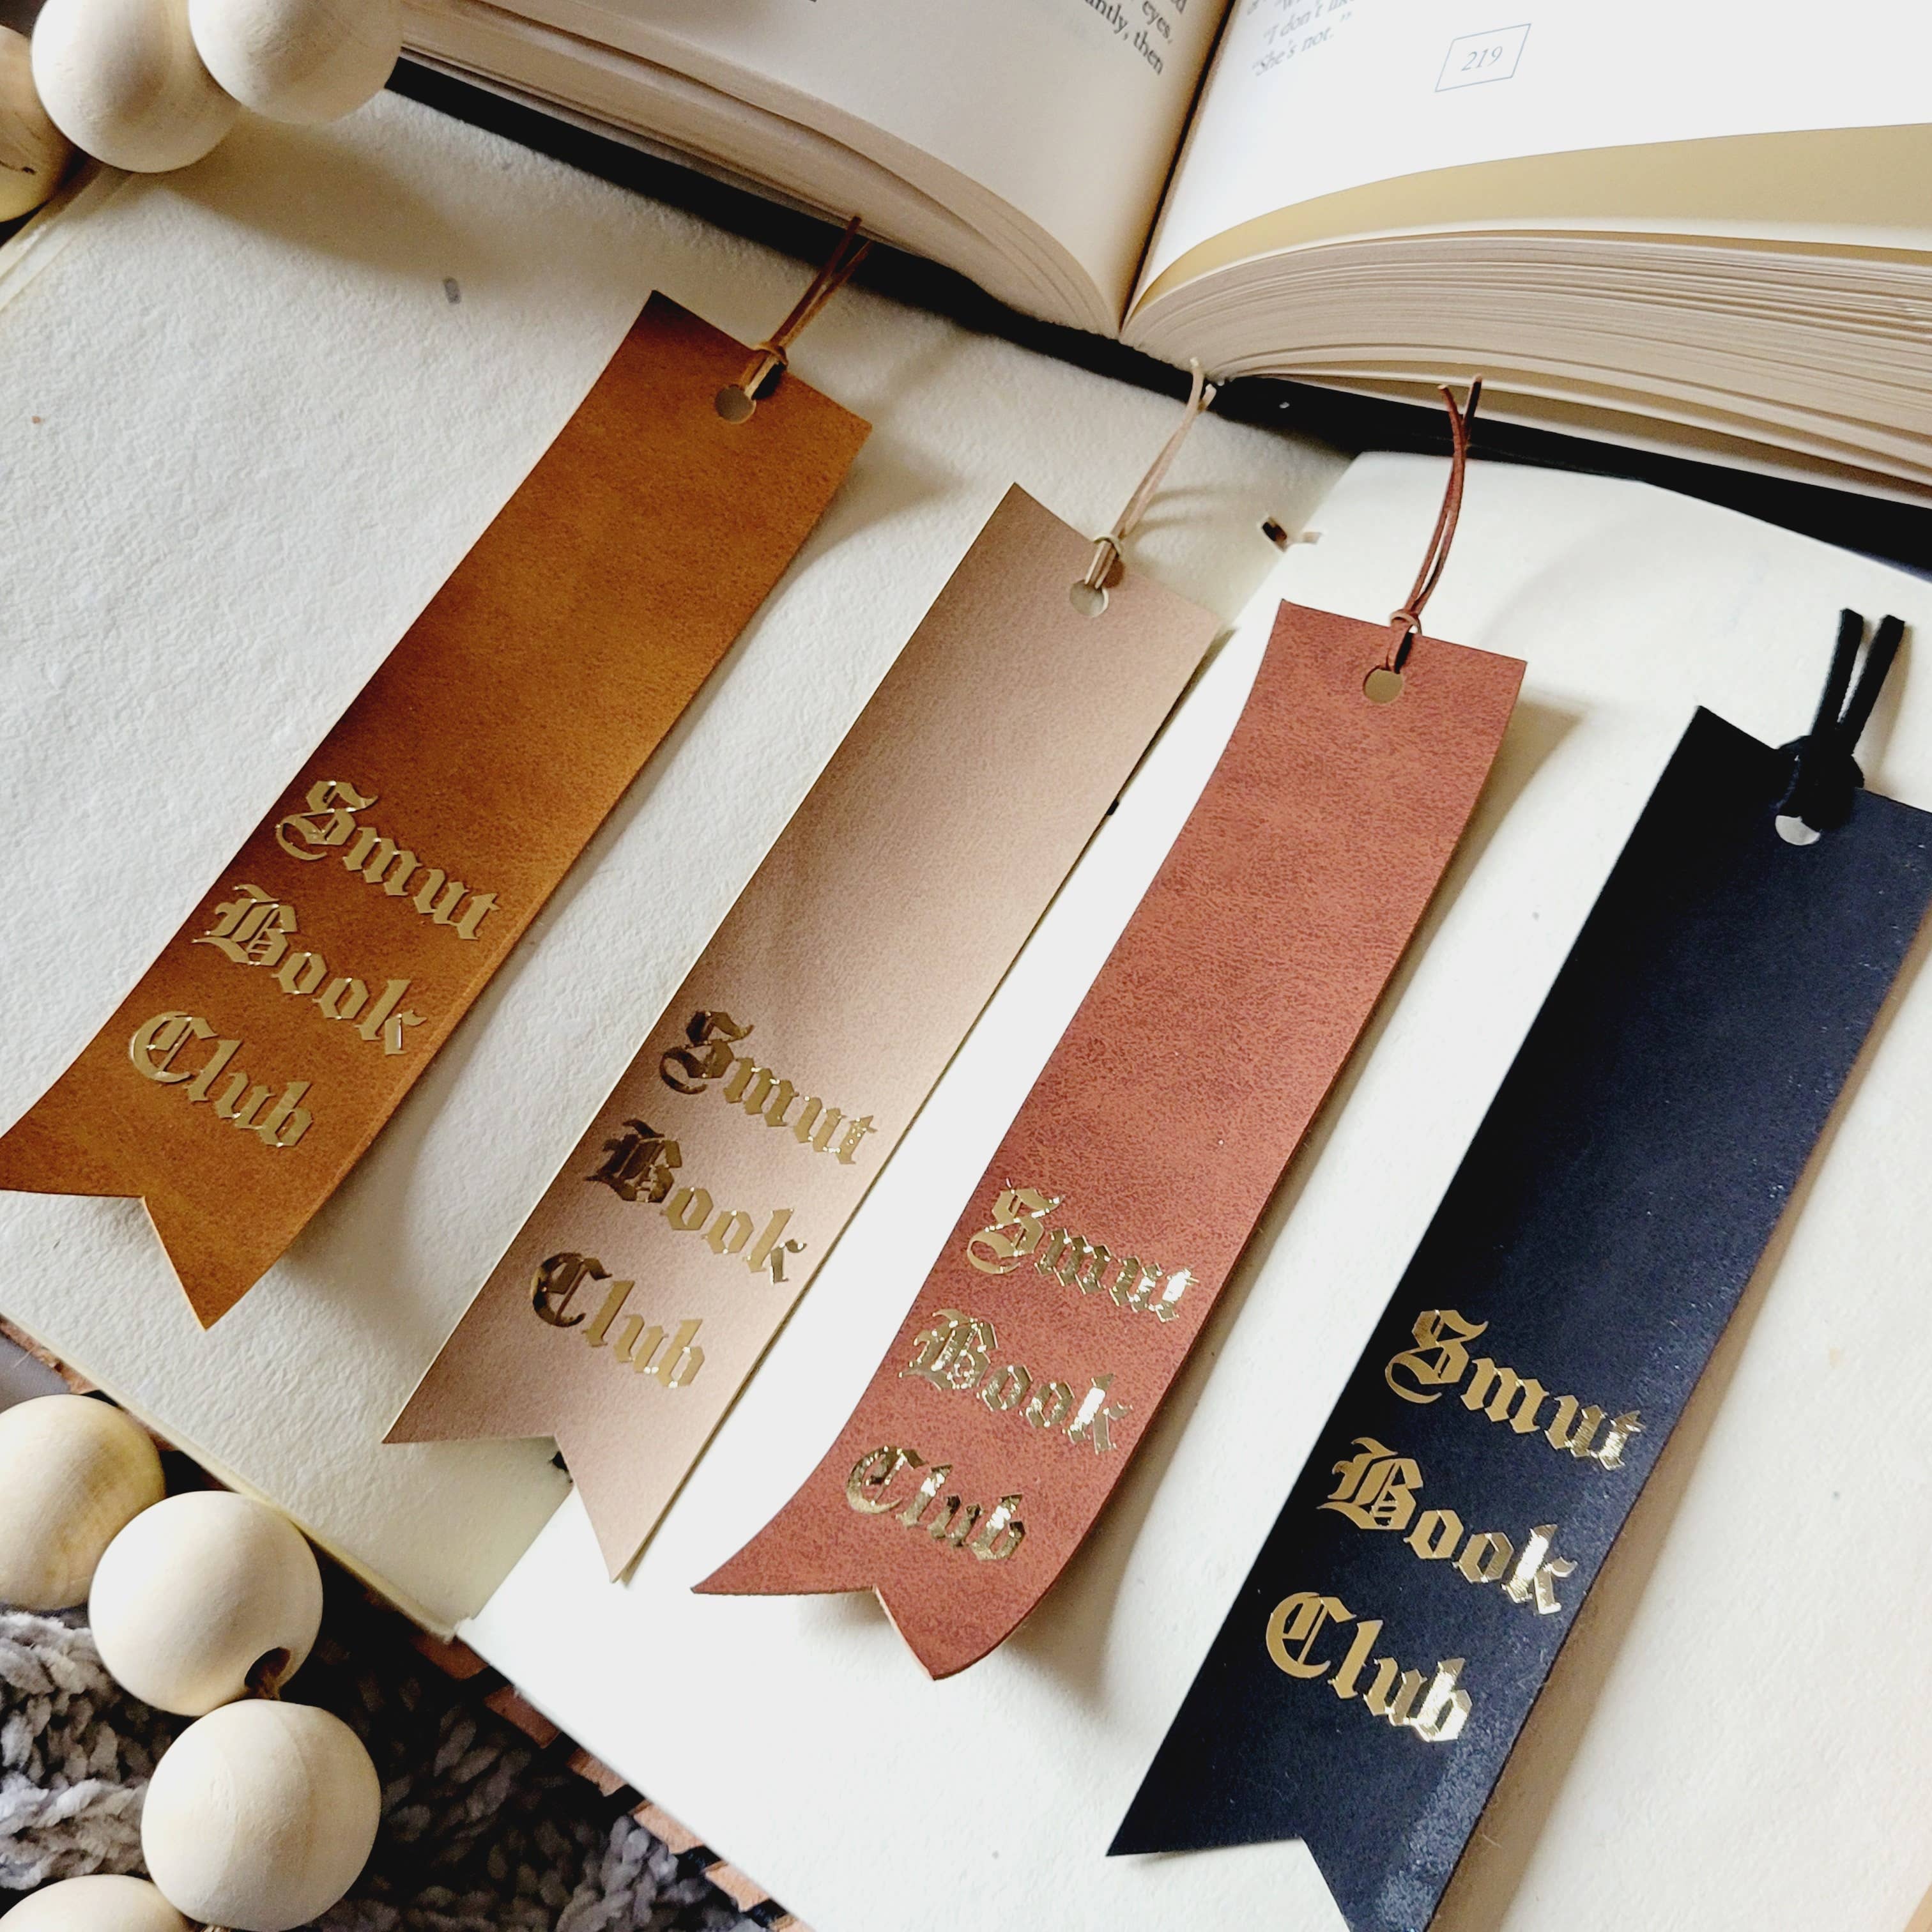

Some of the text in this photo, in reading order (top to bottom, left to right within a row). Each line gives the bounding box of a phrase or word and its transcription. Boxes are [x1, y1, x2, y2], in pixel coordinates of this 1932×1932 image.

[1133, 31, 1163, 75] then
[1461, 46, 1503, 72] 219
[275, 780, 500, 940] Smut
[192, 884, 427, 1055] Book
[130, 1011, 314, 1148] Club
[659, 1011, 878, 1165] Smut
[583, 1118, 808, 1284] Book
[966, 1186, 1199, 1322] Smut
[530, 1252, 705, 1388] Club
[898, 1308, 1133, 1455] Book
[1384, 1309, 1646, 1471] Smut
[845, 1445, 1026, 1561] Club
[1316, 1437, 1578, 1615] Book
[1266, 1591, 1473, 1742] Club
